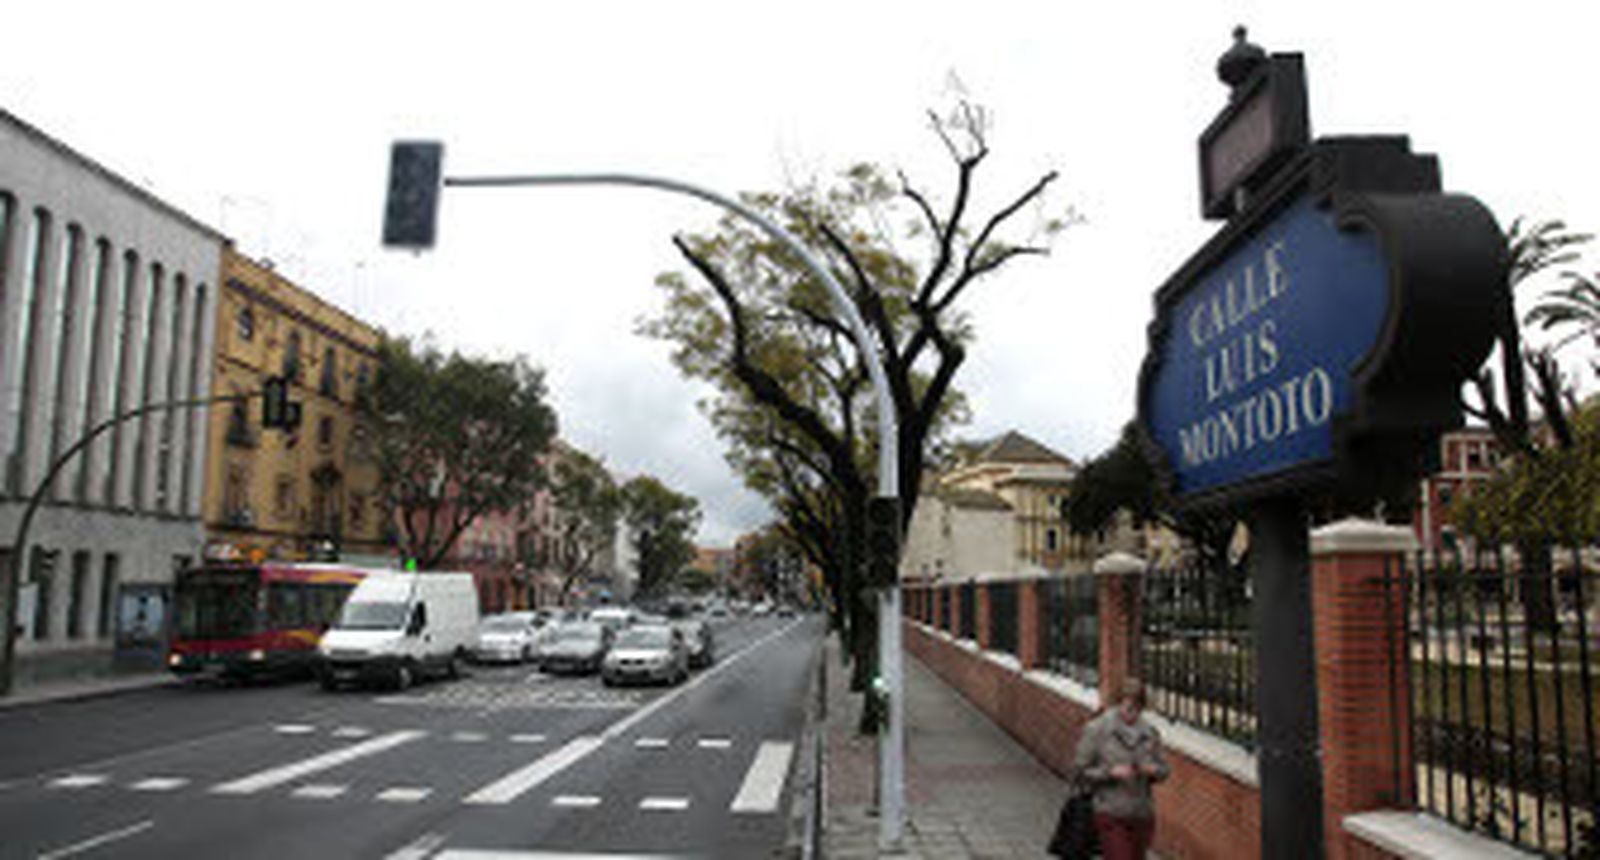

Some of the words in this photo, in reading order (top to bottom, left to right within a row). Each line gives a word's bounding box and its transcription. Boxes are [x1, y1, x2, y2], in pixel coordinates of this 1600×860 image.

[1189, 241, 1288, 347] CALLE
[1206, 319, 1280, 402] LUIS
[1178, 367, 1332, 465] MONTOTO
